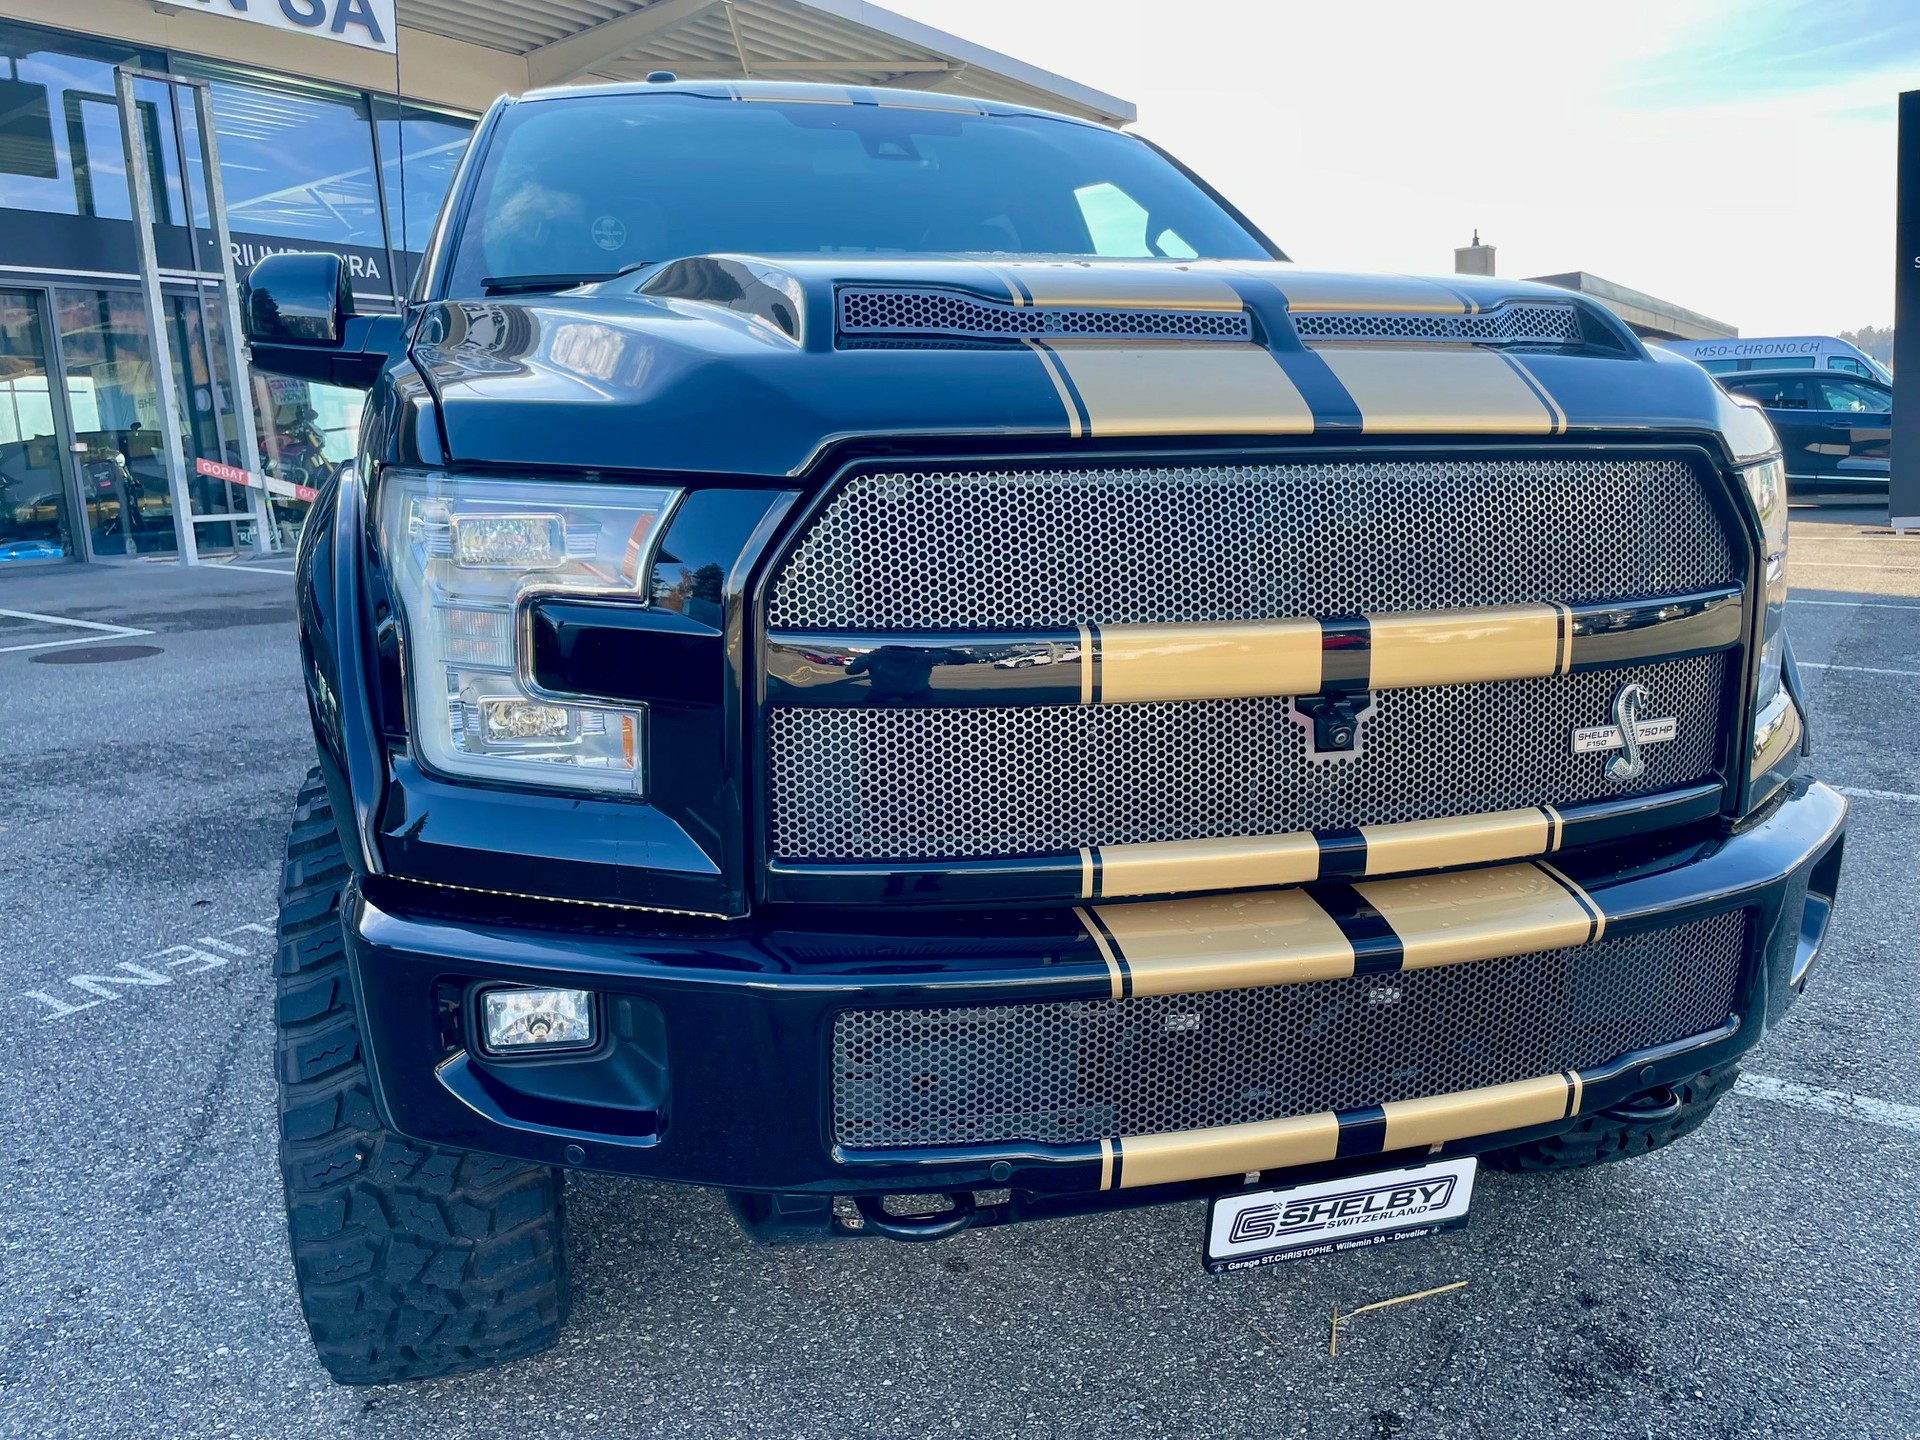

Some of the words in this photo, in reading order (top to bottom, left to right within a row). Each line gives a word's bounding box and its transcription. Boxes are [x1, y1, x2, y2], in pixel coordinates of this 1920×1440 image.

[1694, 342, 1821, 357] MSO-CHRONO.CH
[202, 462, 245, 482] GOBAT
[1578, 730, 1616, 741] SHELBY
[1639, 728, 1658, 737] 750
[1659, 725, 1673, 735] HP
[1586, 739, 1607, 748] F150
[1280, 1182, 1446, 1227] SHELBY
[1326, 1205, 1428, 1229] SWITZERLAND
[1228, 1258, 1260, 1271] Garage
[1336, 1238, 1372, 1251] Willemin
[1373, 1234, 1386, 1244] SA
